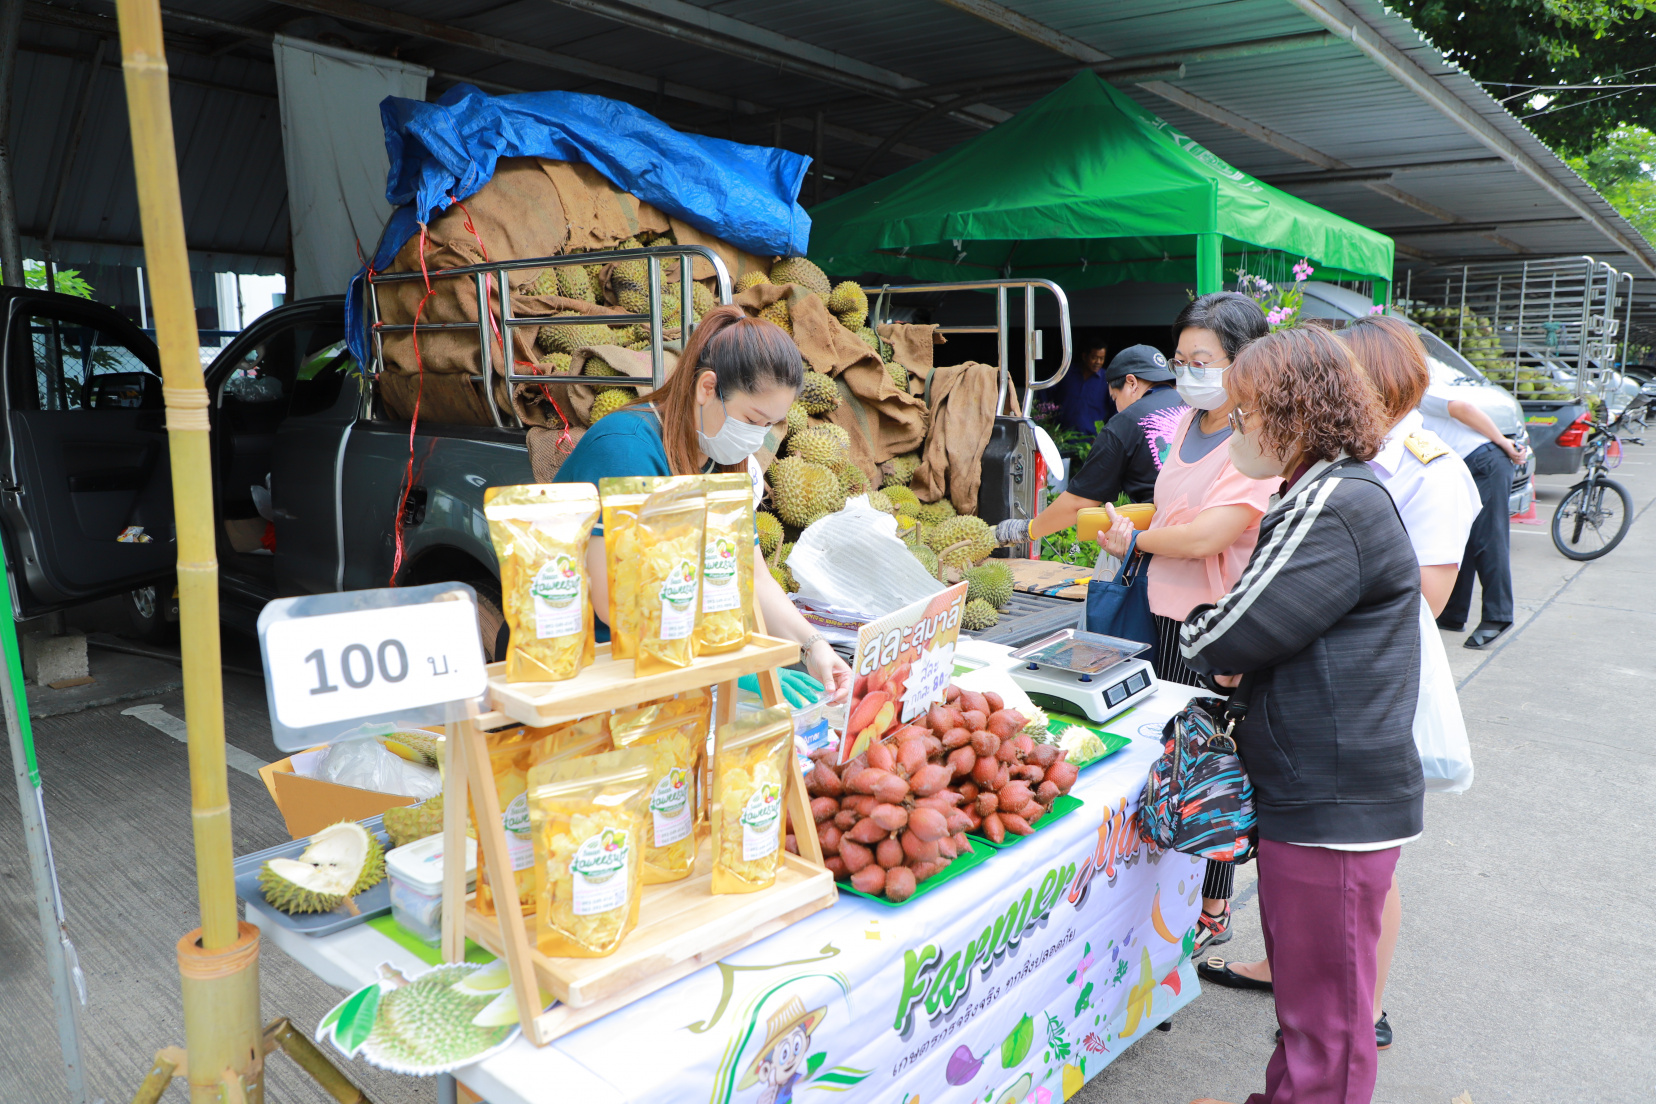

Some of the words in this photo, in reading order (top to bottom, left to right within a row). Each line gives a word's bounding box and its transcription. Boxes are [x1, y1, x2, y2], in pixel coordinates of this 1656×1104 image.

[304, 638, 409, 696] 100
[427, 655, 458, 676] บ.
[860, 594, 962, 677] สละสุมาลี
[893, 861, 1076, 1030] Farmer
